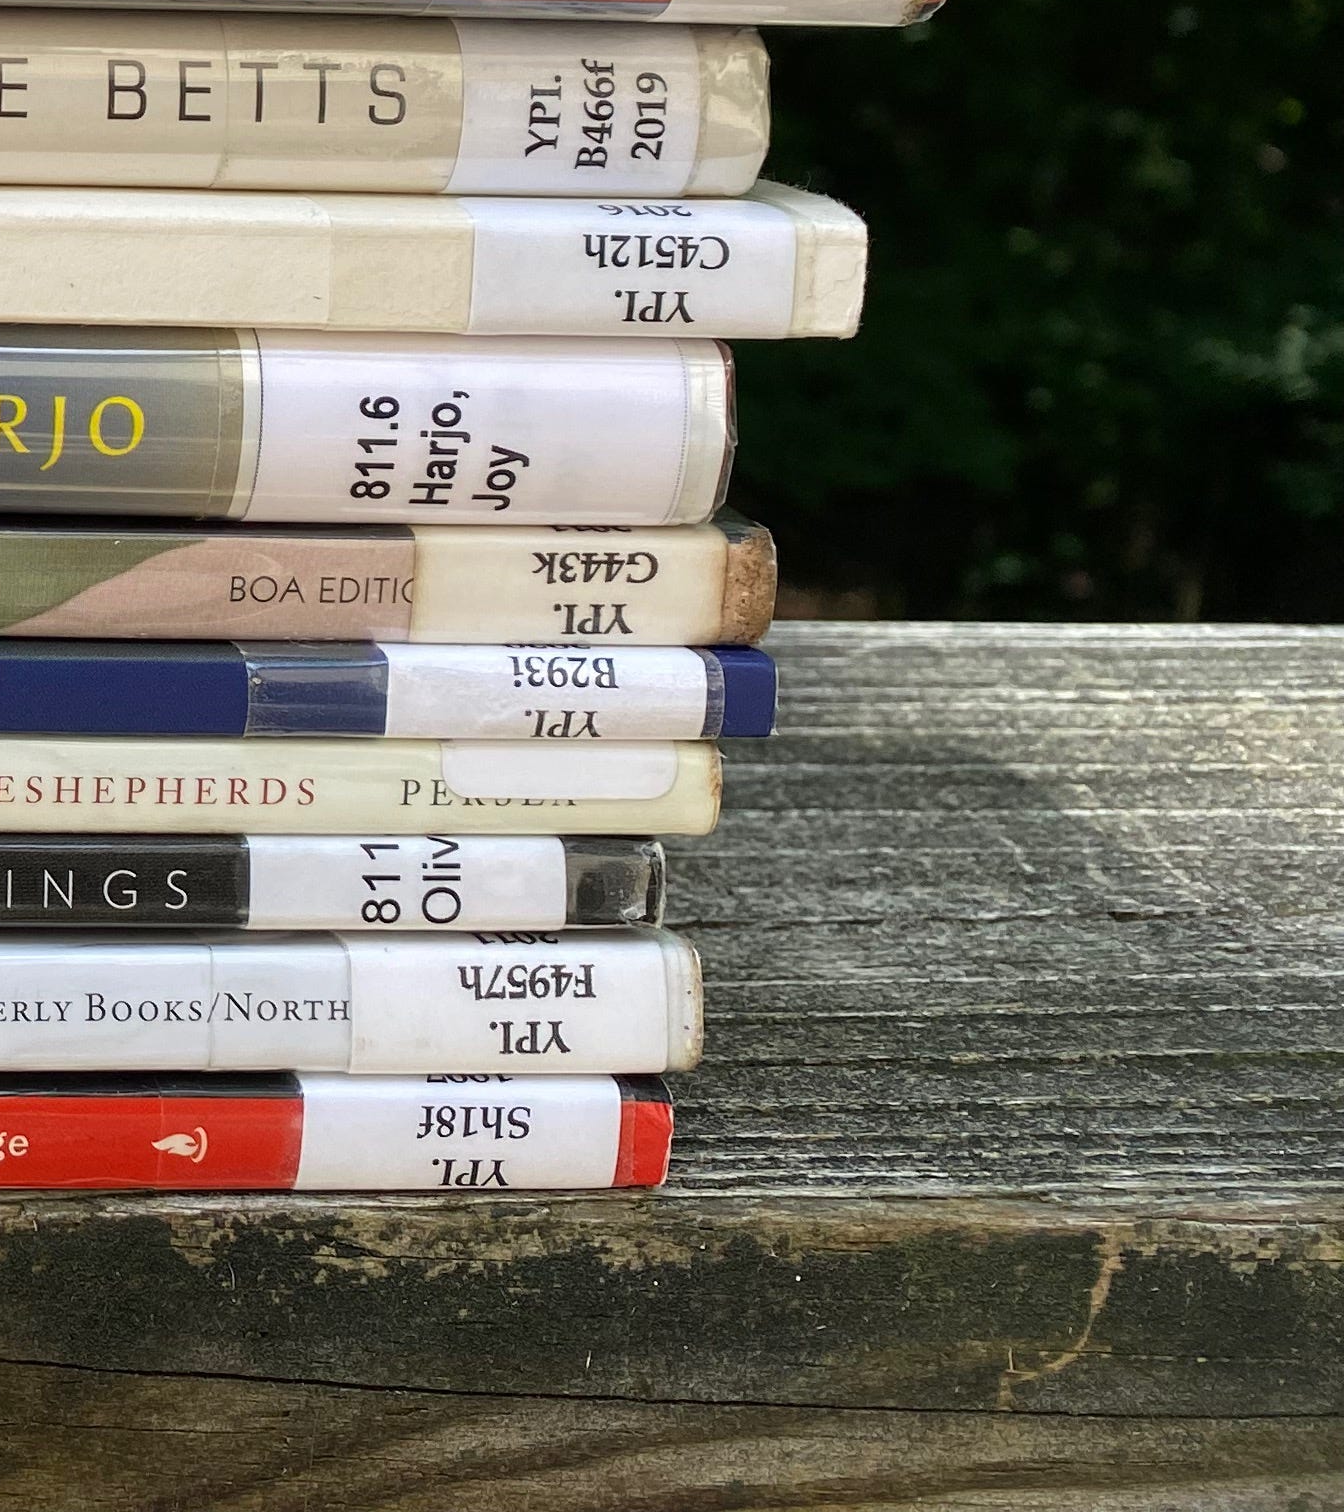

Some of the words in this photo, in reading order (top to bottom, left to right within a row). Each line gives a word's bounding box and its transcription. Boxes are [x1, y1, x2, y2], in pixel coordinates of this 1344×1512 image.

[108, 58, 407, 126] BETTS
[576, 59, 616, 170] B466f
[631, 71, 667, 161] 2019
[582, 234, 730, 270] C4512h
[351, 395, 400, 500] 811.6
[410, 390, 470, 506] Harjo,
[472, 444, 529, 512] Joy
[230, 576, 305, 603] BOA
[532, 552, 658, 584] G443k
[510, 655, 619, 689] B293i
[360, 840, 402, 924] 811
[457, 964, 597, 1000] F4957h
[417, 1105, 531, 1139] Sh18f
